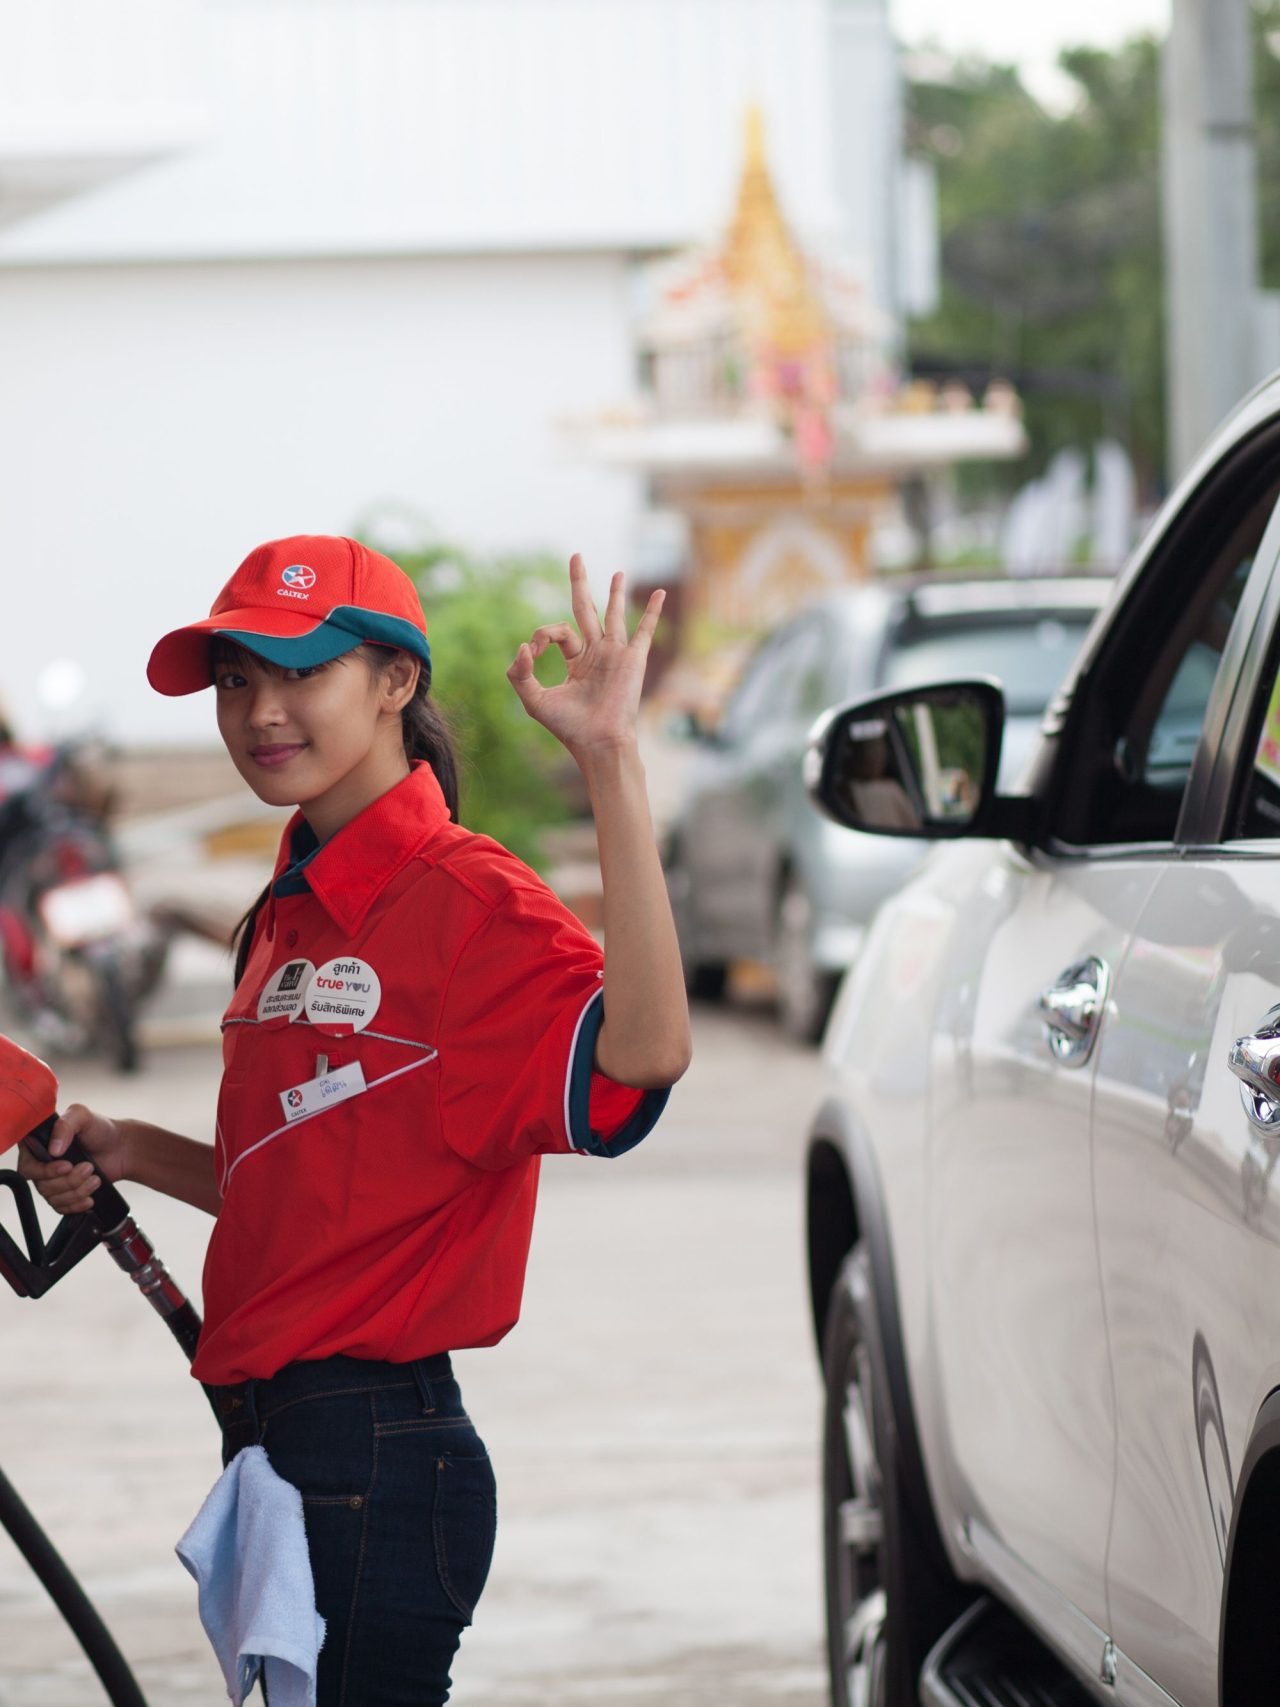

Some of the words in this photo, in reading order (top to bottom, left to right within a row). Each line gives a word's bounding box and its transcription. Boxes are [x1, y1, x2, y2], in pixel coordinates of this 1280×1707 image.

[277, 589, 309, 600] CALTEX
[333, 961, 361, 975] ลูกค้า
[316, 976, 344, 990] true
